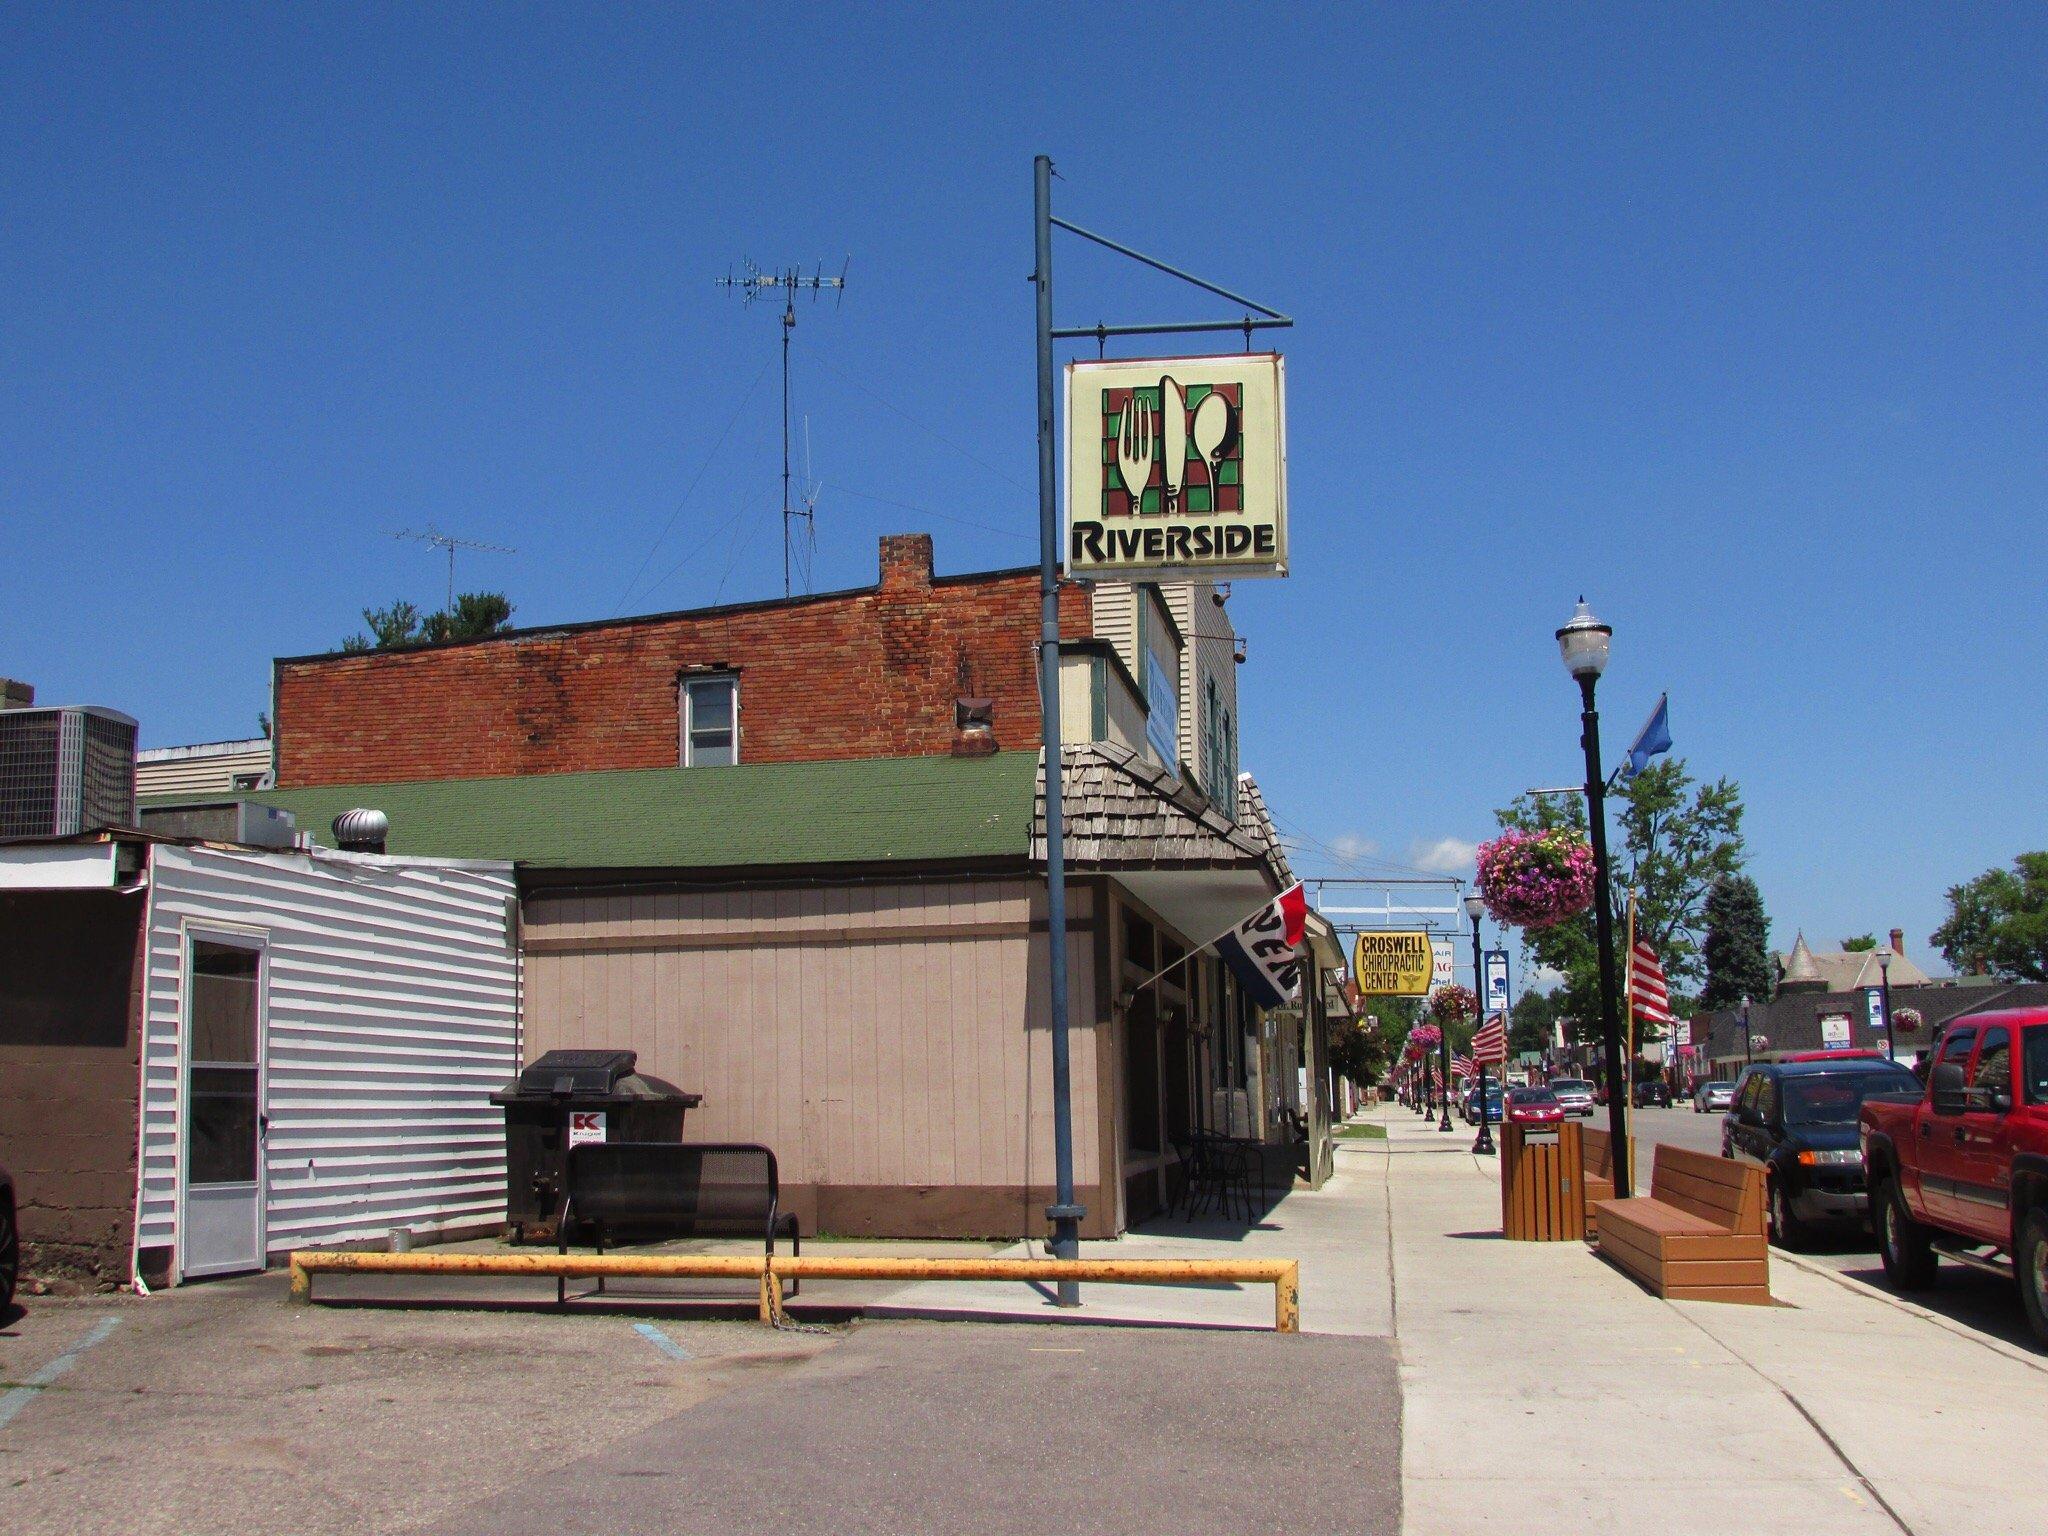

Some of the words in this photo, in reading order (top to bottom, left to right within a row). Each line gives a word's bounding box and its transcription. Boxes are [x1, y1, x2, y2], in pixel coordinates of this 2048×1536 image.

[1241, 903, 1301, 991] PEN
[1362, 936, 1425, 954] CROSWELL
[1362, 954, 1424, 972] CHIROPRACTIC
[1365, 972, 1398, 990] CENTER
